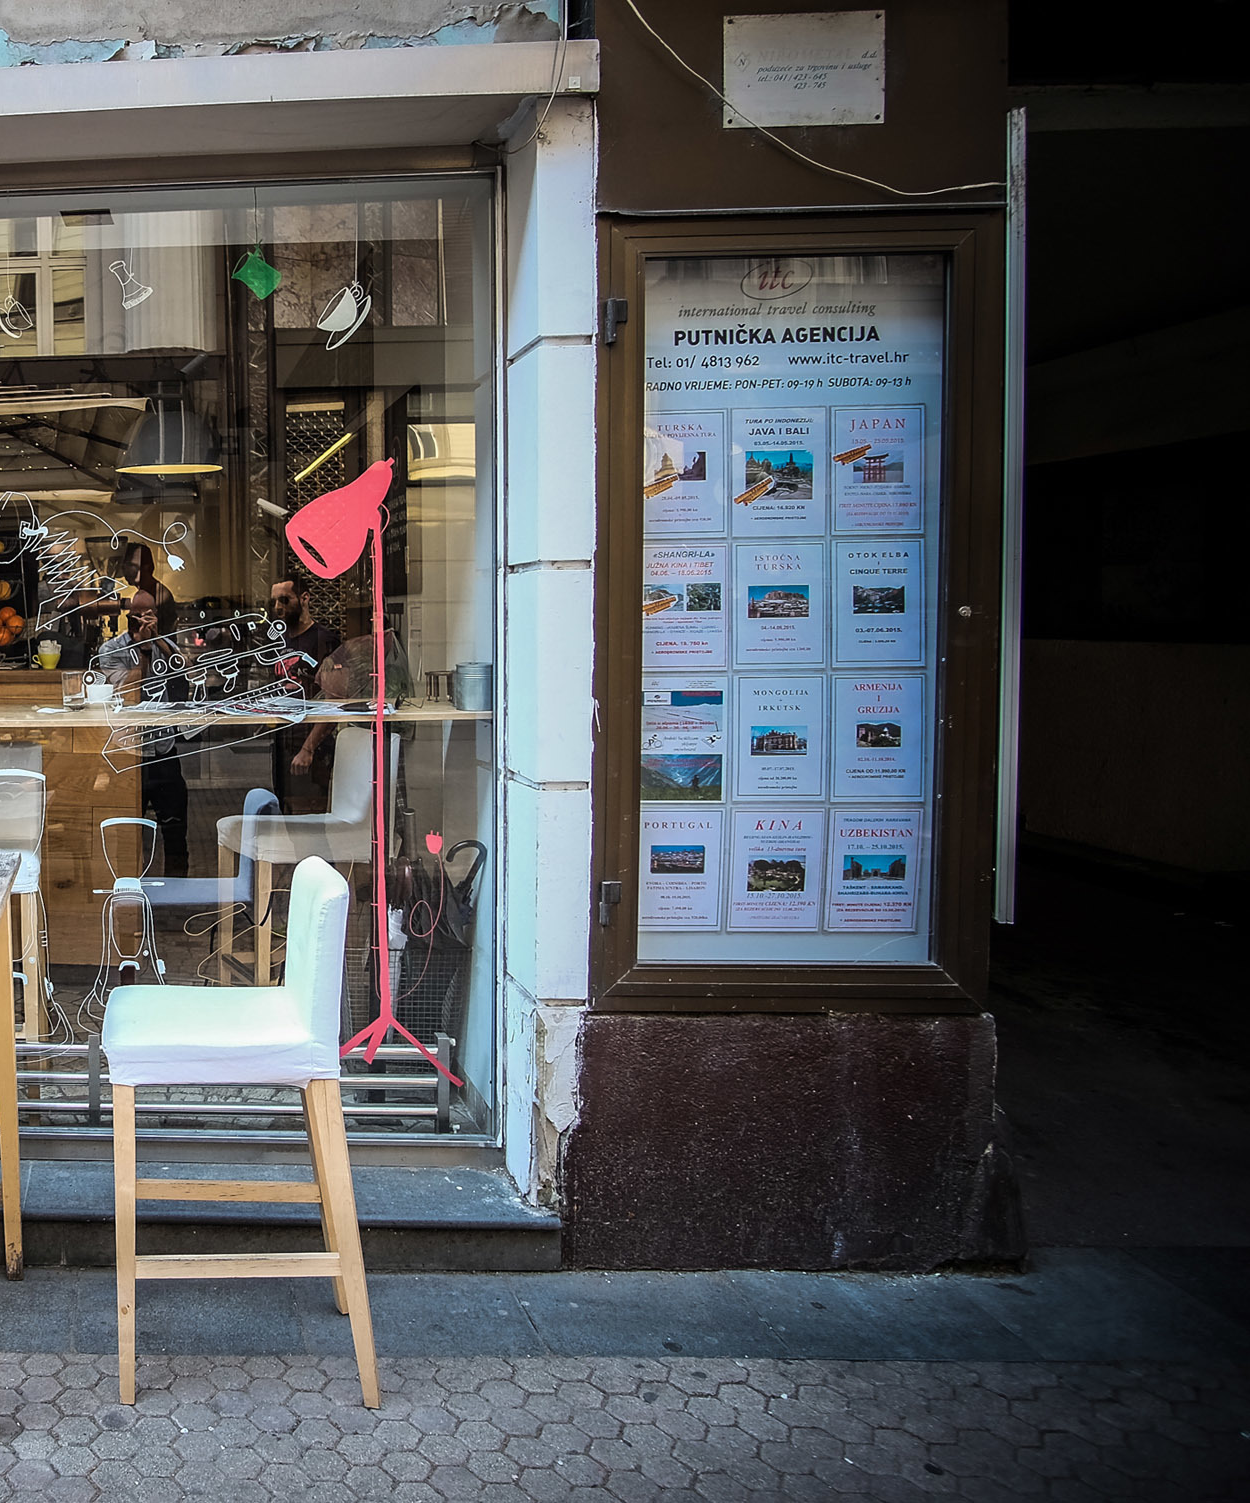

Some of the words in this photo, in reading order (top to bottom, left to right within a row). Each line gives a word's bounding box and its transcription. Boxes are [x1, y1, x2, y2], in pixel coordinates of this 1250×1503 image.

[758, 266, 795, 290] itc
[678, 303, 761, 318] international
[766, 302, 806, 314] travel
[812, 301, 876, 316] consulting
[674, 324, 776, 346] PUTNIČKA
[780, 326, 880, 344] AGENCIJA
[646, 357, 672, 368] Tel:
[676, 355, 696, 368] 01/
[701, 356, 732, 368] 4813
[736, 354, 760, 368] 962
[788, 352, 909, 365] www.itc-travel.hr
[646, 382, 682, 392] RADNO
[685, 380, 732, 390] VRIJEME:
[735, 379, 785, 390] PON-PET:
[787, 379, 814, 390] 09-19
[816, 378, 823, 388] h
[828, 377, 873, 388] SUBOTA:
[876, 378, 903, 388] 09-13
[904, 377, 912, 386] h
[657, 423, 704, 432] TURSKA
[850, 418, 906, 432] JAPAN
[748, 427, 776, 436] JAVA
[785, 426, 810, 435] BALI
[756, 563, 802, 571] TURSKA
[853, 683, 903, 691] ARMENIJA
[857, 706, 900, 714] GRUZIJA
[644, 821, 713, 829] PORTUGAL
[754, 819, 803, 831] KINA
[840, 828, 914, 838] UZBEKISTAN
